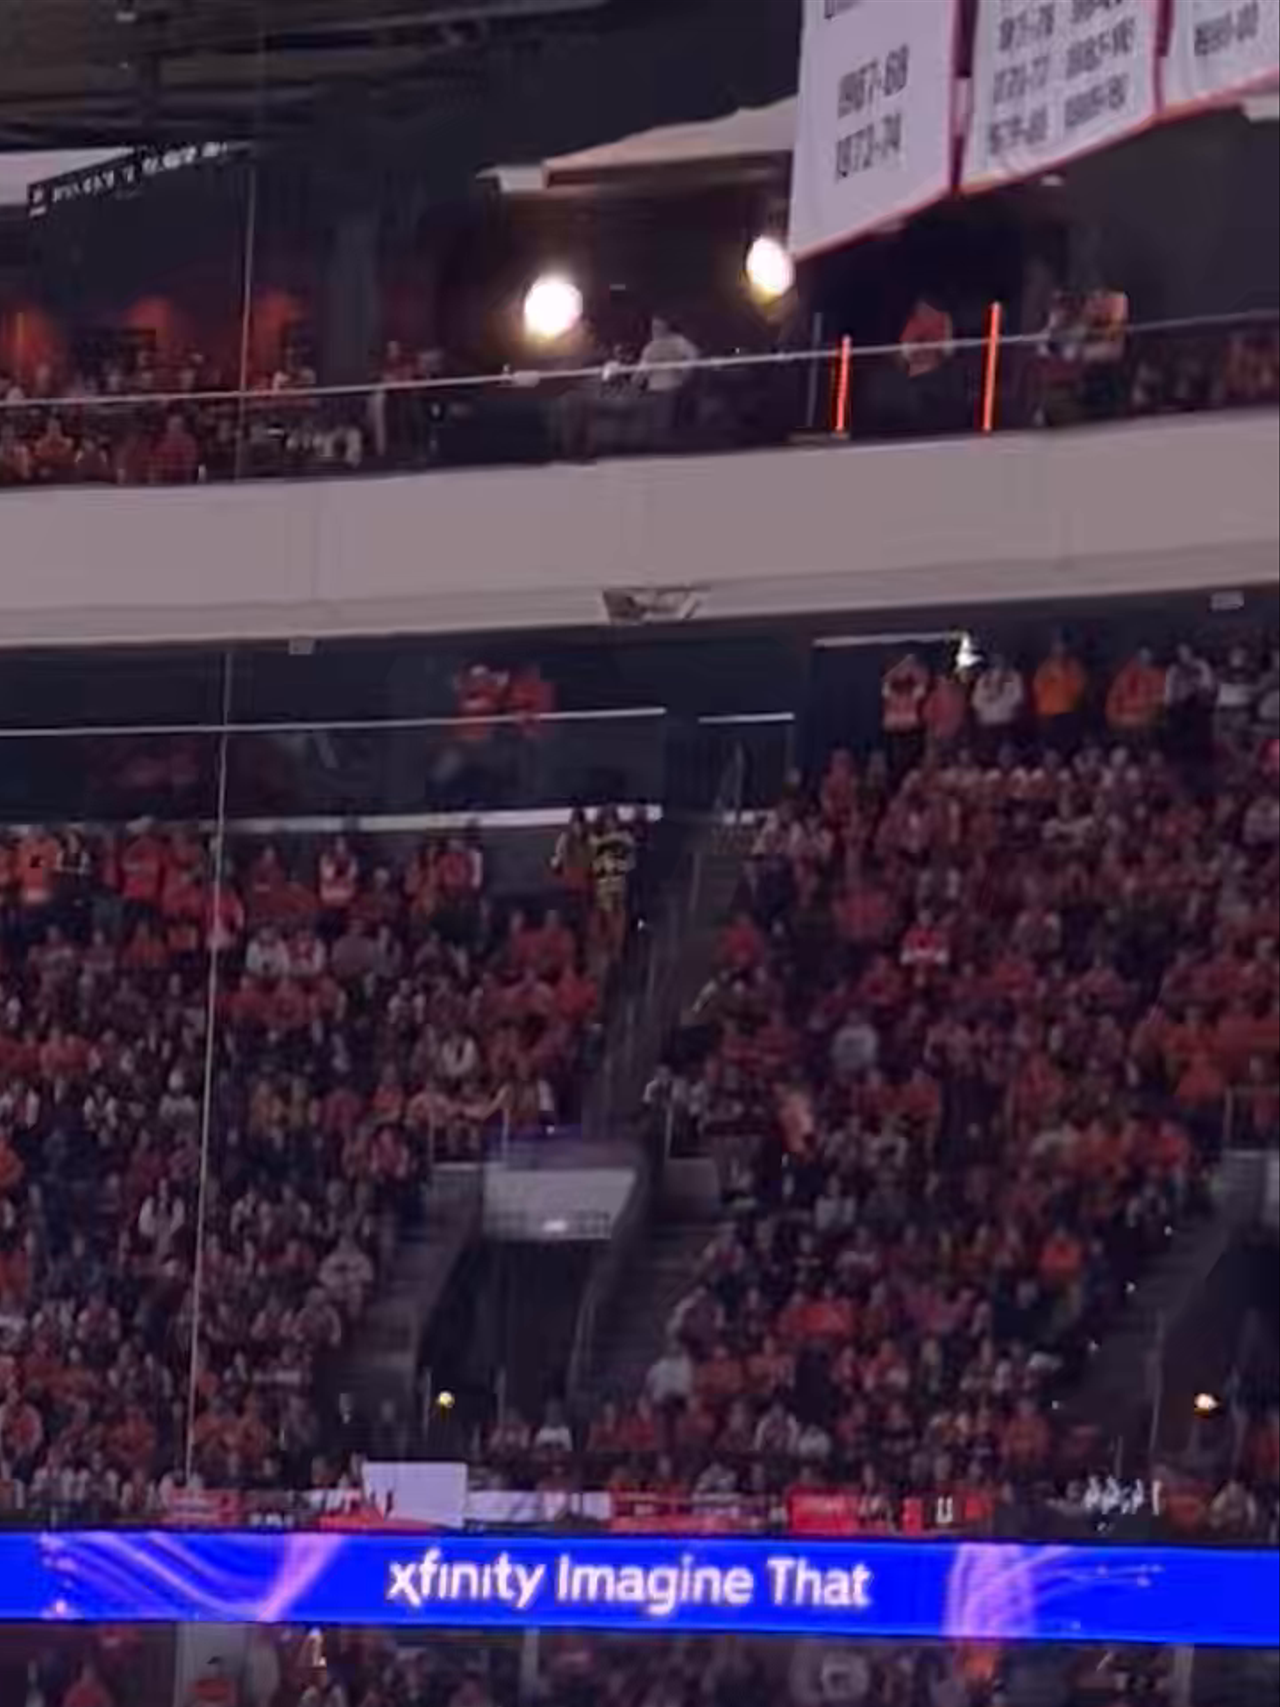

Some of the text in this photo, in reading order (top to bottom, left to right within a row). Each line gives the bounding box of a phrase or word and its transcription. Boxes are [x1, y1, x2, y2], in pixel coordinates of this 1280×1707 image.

[386, 1547, 872, 1615] xfinity Imagine That
